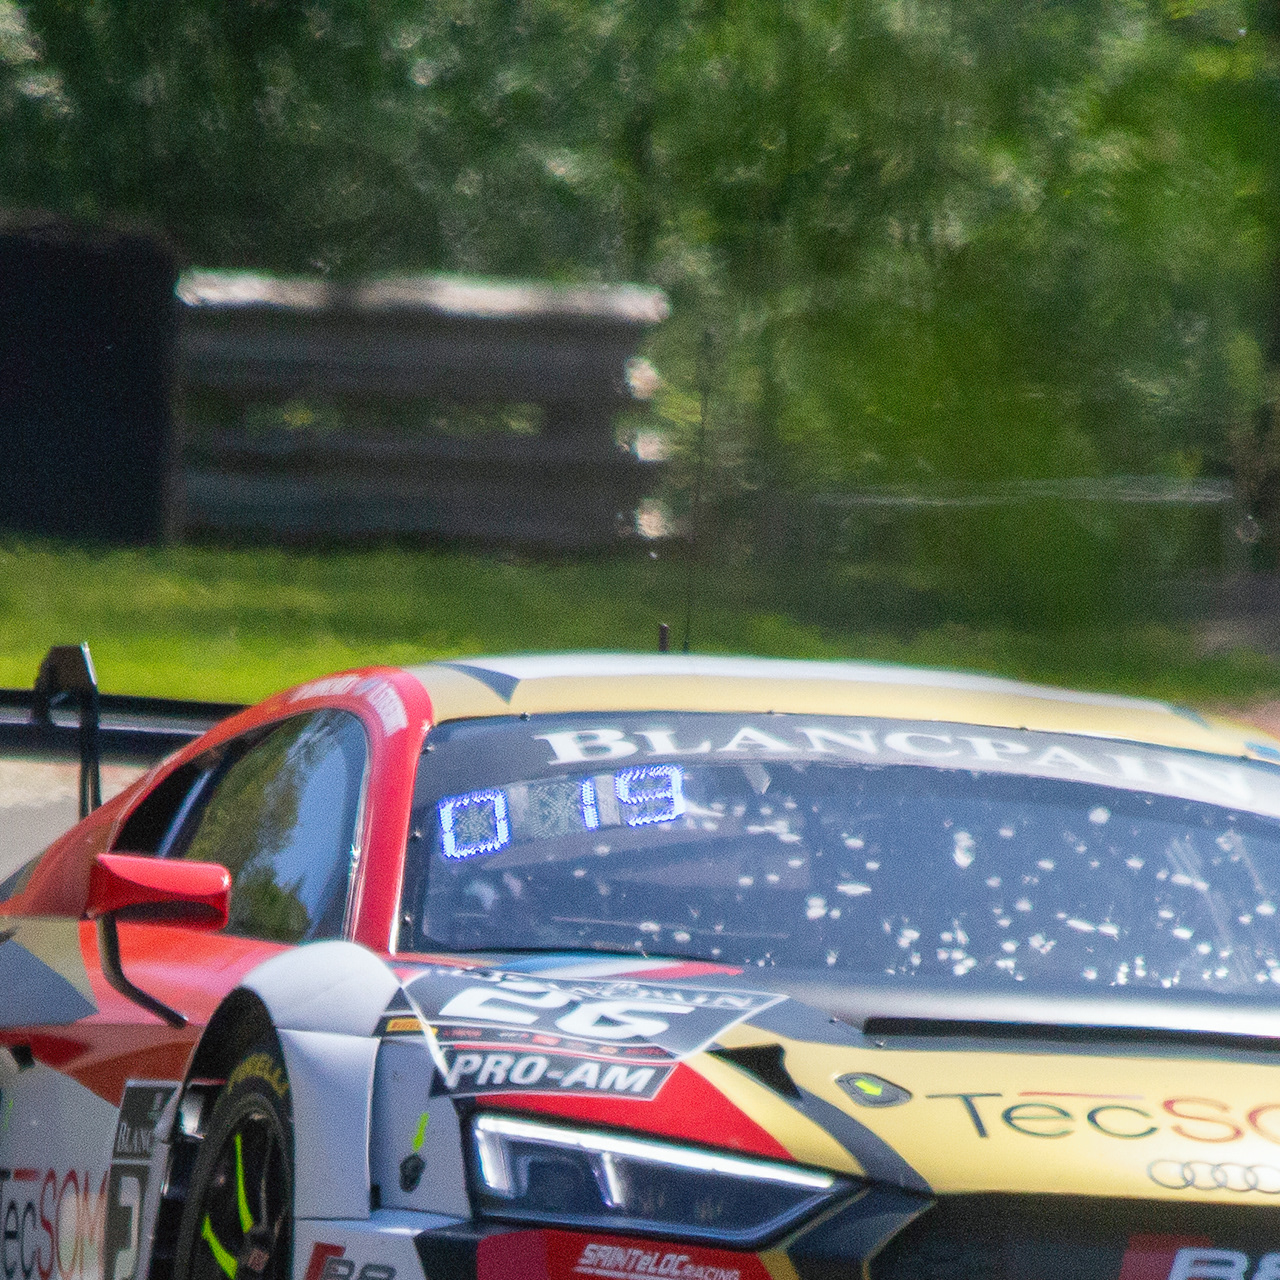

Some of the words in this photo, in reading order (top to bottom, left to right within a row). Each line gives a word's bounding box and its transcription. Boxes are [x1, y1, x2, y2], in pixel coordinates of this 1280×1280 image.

[532, 724, 1252, 801] BLANCPAIN
[439, 981, 696, 1040] 26
[445, 1052, 658, 1094] PRO-AM
